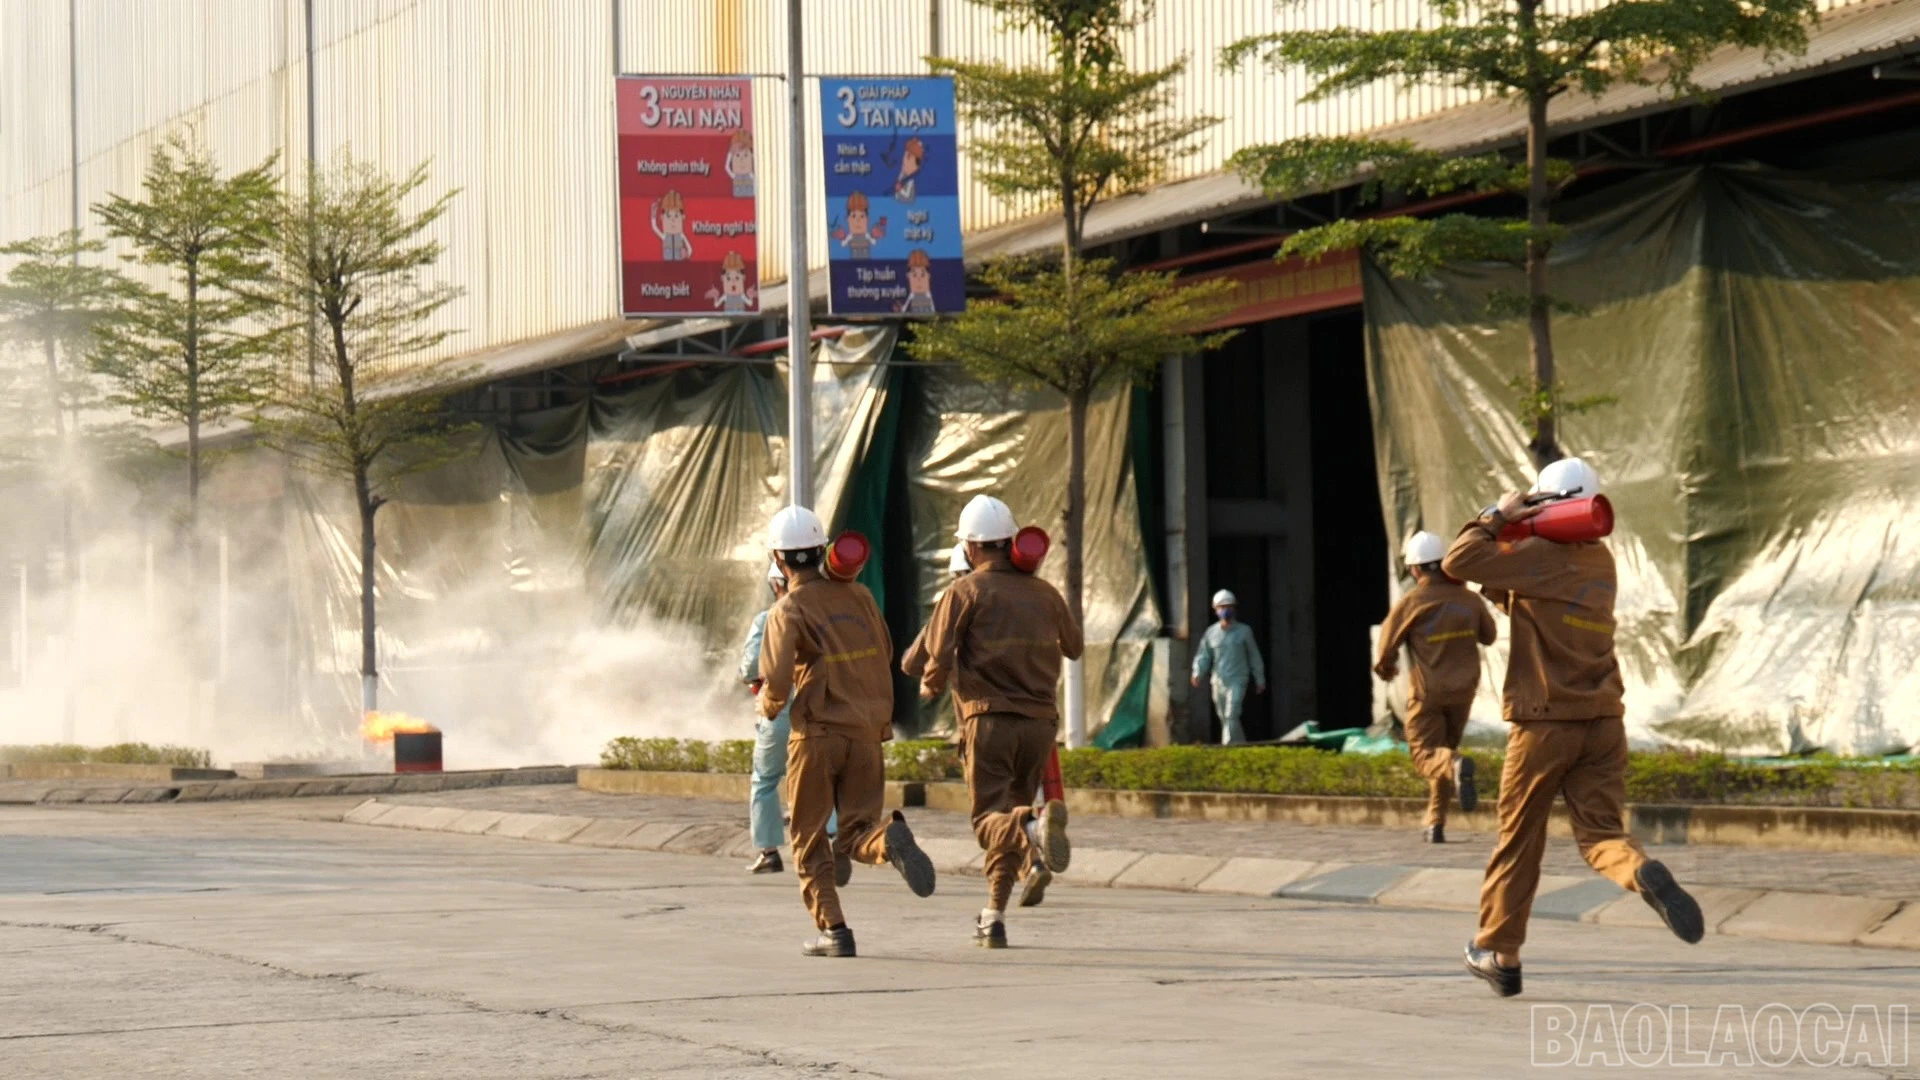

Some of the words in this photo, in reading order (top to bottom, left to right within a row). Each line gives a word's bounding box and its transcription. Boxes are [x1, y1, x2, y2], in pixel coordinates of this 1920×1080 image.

[662, 83, 707, 98] NGUYÊN
[711, 83, 740, 98] NHÂN
[640, 85, 661, 126] 3
[837, 86, 857, 127] 3
[662, 108, 693, 126] TAI
[700, 108, 741, 130] NẠN
[862, 109, 889, 127] TAI
[895, 108, 935, 131] NẠN
[637, 159, 667, 176] Không
[692, 220, 722, 236] Không
[641, 282, 671, 299] Không
